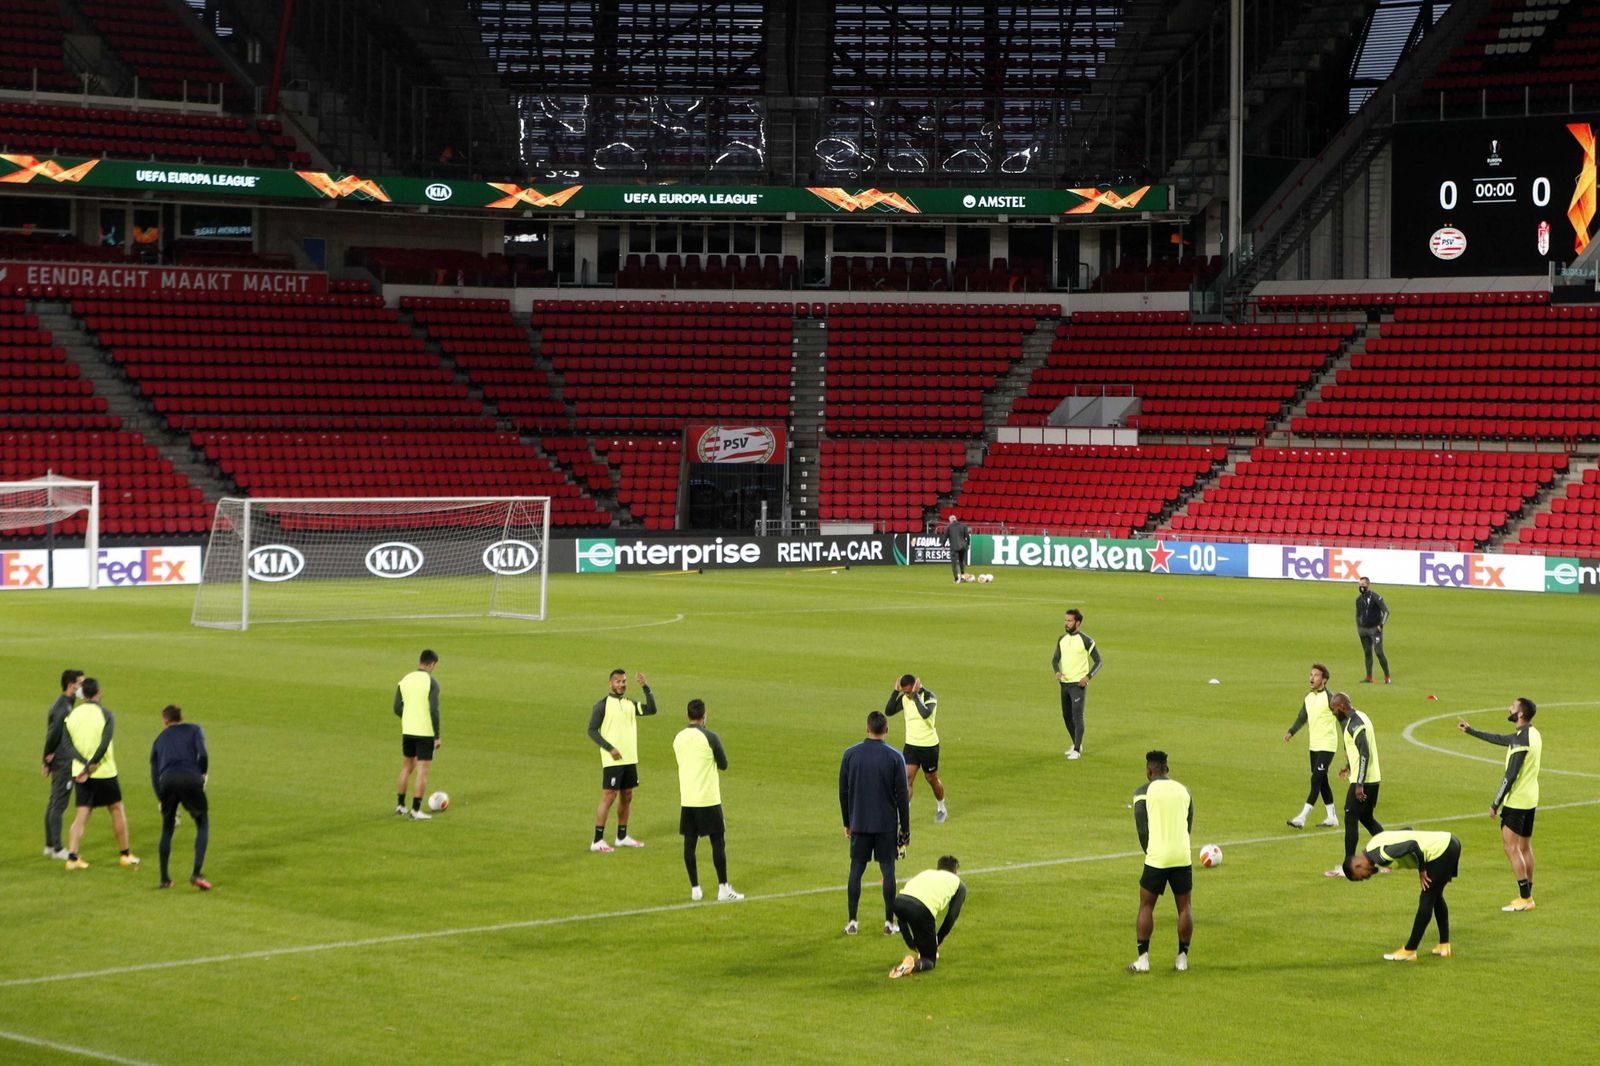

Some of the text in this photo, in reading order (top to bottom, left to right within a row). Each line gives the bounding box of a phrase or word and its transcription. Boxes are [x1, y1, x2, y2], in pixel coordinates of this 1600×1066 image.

[136, 170, 167, 182] UEFA
[168, 171, 211, 185] EUROPA
[623, 193, 657, 204] UEFA
[659, 193, 707, 204] EUROPA
[977, 195, 1026, 208] AMSTEL
[1440, 177, 1550, 210] 0 00:00 0
[27, 266, 309, 293] EENDRACHT MAAKT MACHT
[723, 437, 749, 450] PSV
[253, 552, 295, 573] KIA
[375, 550, 415, 571] KIA
[491, 548, 530, 568] KIA
[580, 537, 883, 571] enterprise RENT-A-CAR
[925, 550, 951, 559] RESPE
[991, 535, 1144, 571] Heineken
[1282, 546, 1361, 580] FedEx
[98, 549, 185, 584] FedEx
[1419, 552, 1505, 588] FedEx
[1550, 562, 1600, 586] en
